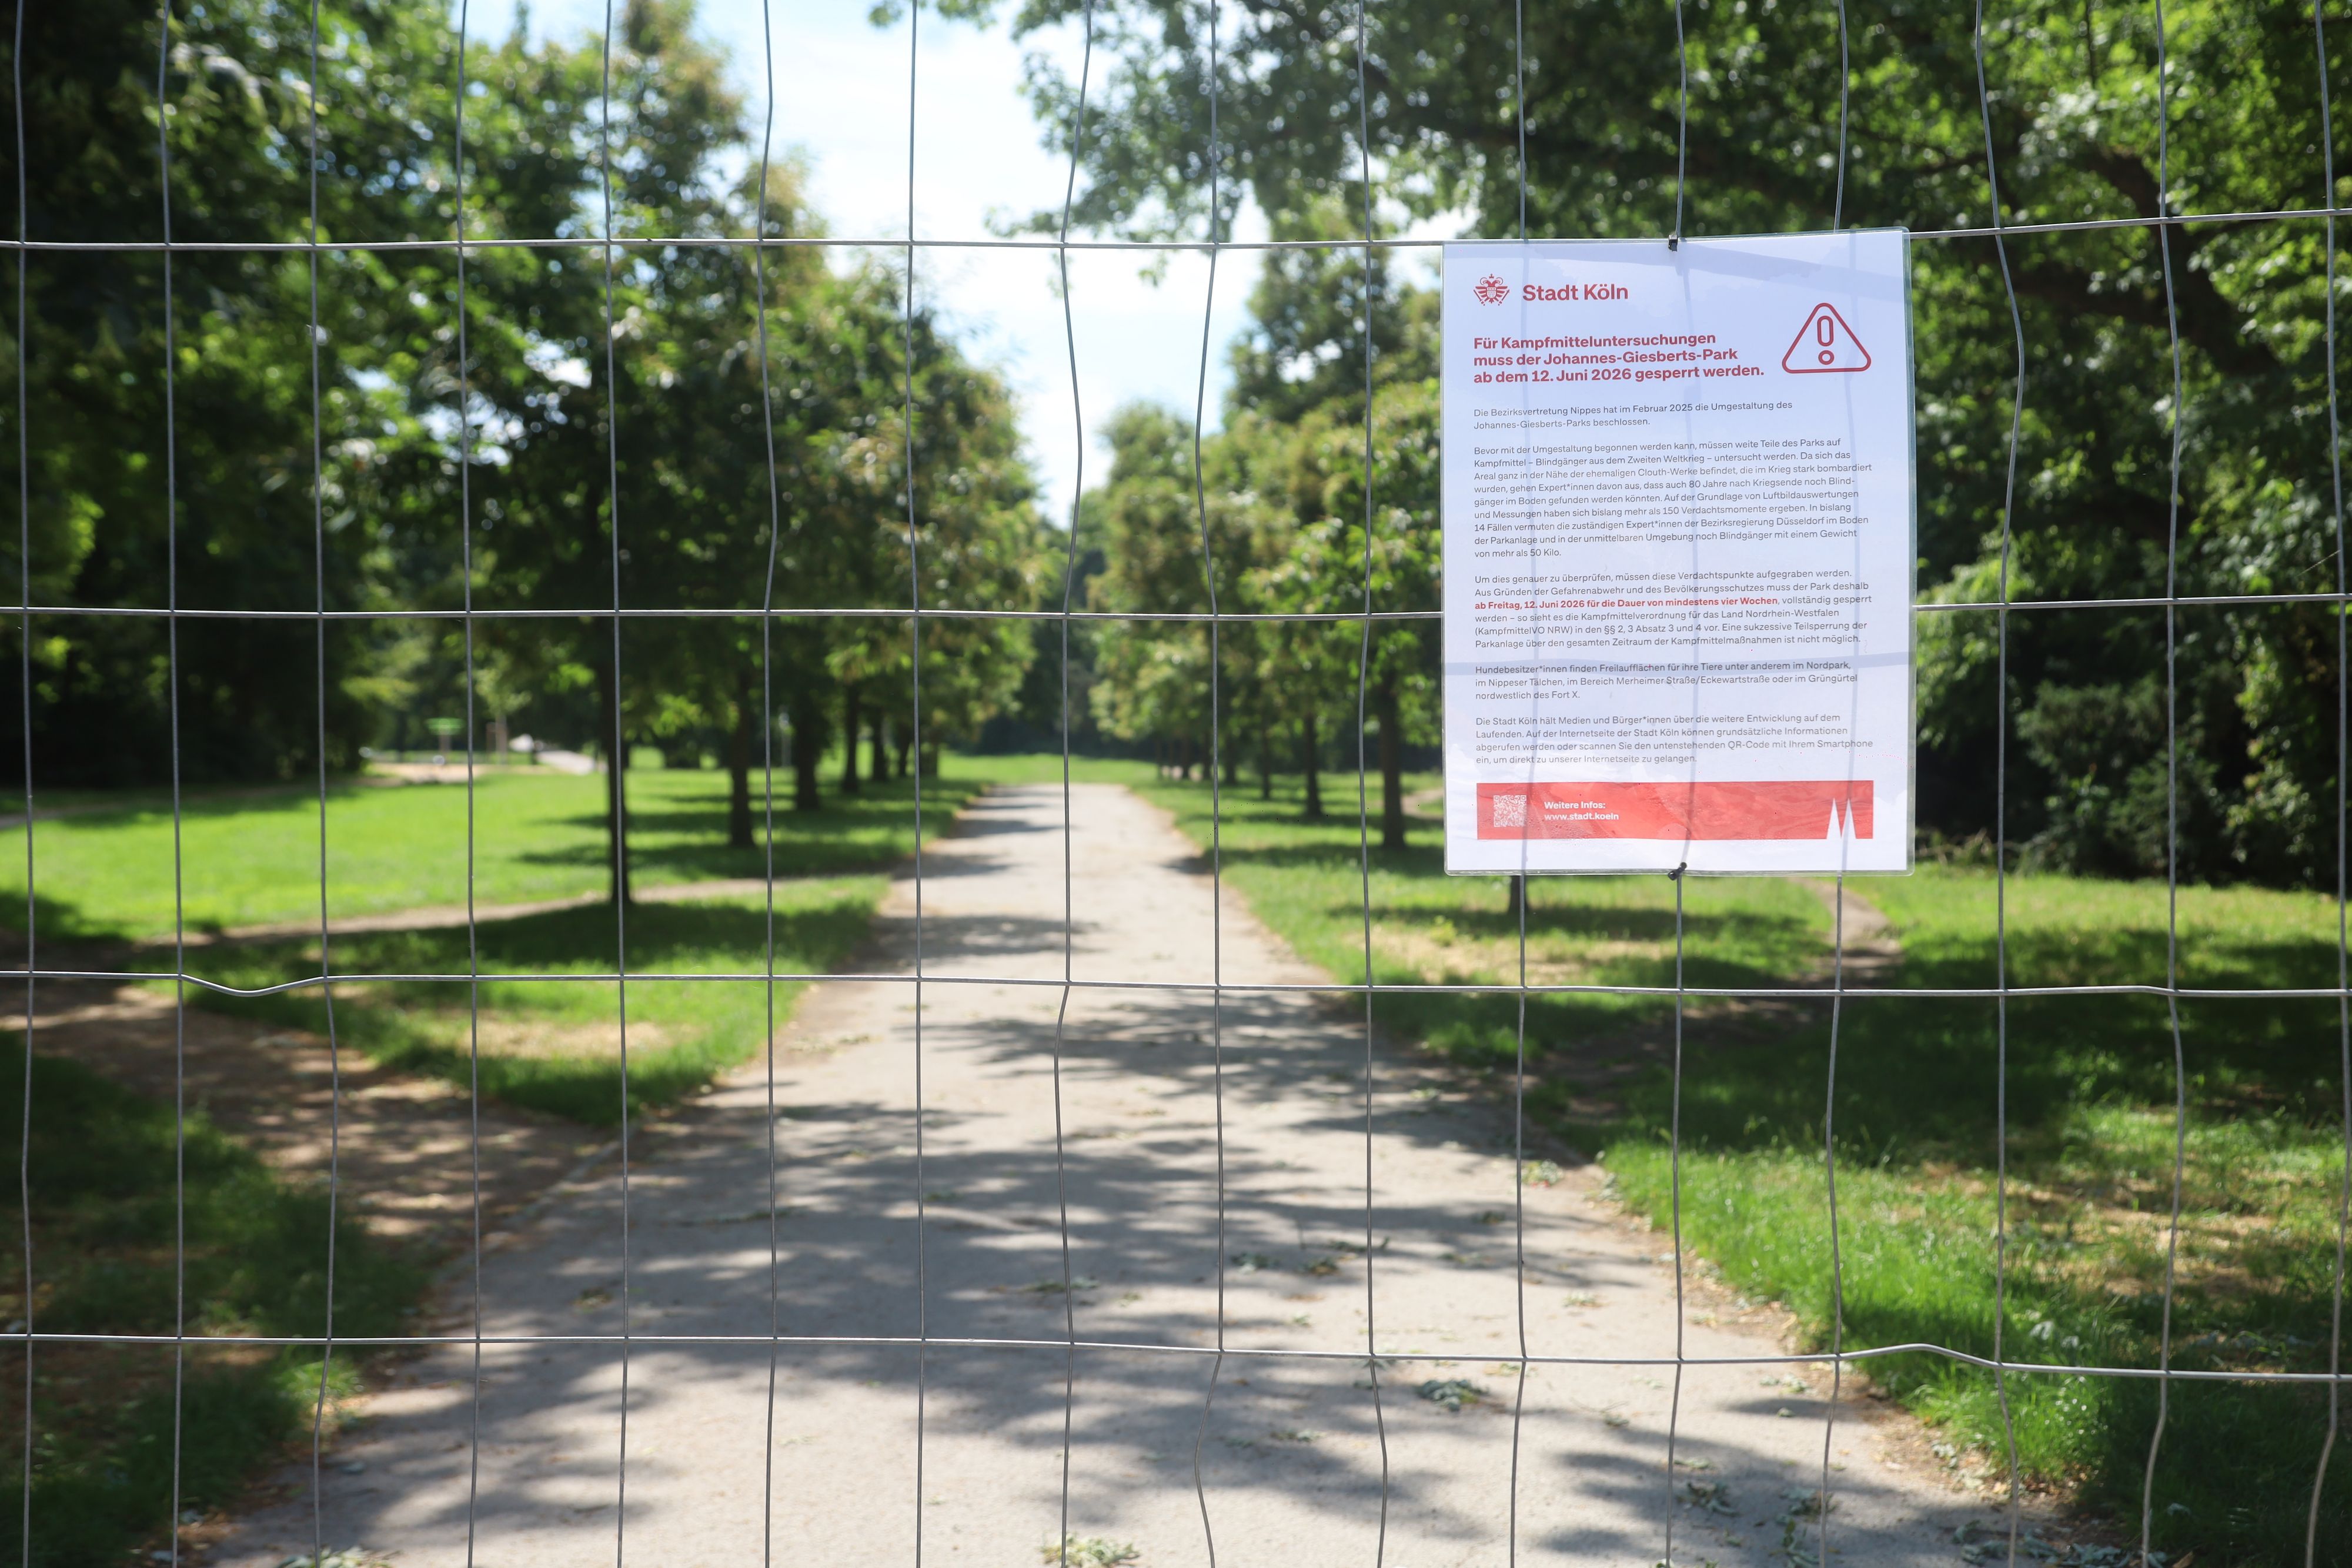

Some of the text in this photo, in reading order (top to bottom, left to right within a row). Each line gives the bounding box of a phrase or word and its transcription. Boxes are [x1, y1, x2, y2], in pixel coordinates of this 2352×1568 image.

[1522, 283, 1628, 302] Stadt Köln
[1474, 333, 1716, 351] Für Kampfmitteluntersuchungen
[1474, 347, 1738, 366] muss der Johannes-Giesberts-Park
[1474, 364, 1765, 383] ab dem 12. Juni 2026 gesperrt werden.
[1474, 409, 1489, 417] Die
[1491, 407, 1568, 417] Bezirksvertretung
[1571, 406, 1601, 416] Nippes
[1619, 405, 1631, 413] im
[1633, 404, 1668, 413] Februar
[1669, 403, 1693, 412] 2025
[1695, 403, 1709, 411] die
[1711, 402, 1774, 412] Umgestaltung
[1474, 418, 1651, 430] Johannes-Giesberts-Parks beschlossen.
[1474, 498, 1504, 508] gänger
[1505, 497, 1516, 505] im
[1518, 497, 1546, 505] Boden
[1548, 496, 1589, 506] gefunden
[1591, 495, 1623, 503] werden
[1625, 494, 1663, 503] könnten.
[1663, 493, 1680, 502] Auf
[1681, 493, 1696, 502] der
[1696, 492, 1743, 502] Grundlage
[1763, 491, 1859, 500] Luftbildauswertungen
[1474, 511, 1491, 519] und
[1492, 510, 1542, 520] Messungen
[1544, 509, 1571, 517] haben
[1572, 509, 1590, 517] sich
[1592, 508, 1622, 518] bislang
[1624, 507, 1647, 516] mehr
[1662, 506, 1679, 515] 150
[1681, 505, 1767, 514] Verdachtsmomente
[1769, 504, 1808, 514] ergeben.
[1819, 503, 1852, 513] bislang
[1474, 524, 1485, 532] 14
[1487, 523, 1512, 531] Fällen
[1514, 523, 1555, 531] vermuten
[1556, 521, 1570, 530] die
[1572, 521, 1624, 531] zuständigen
[1684, 519, 1699, 527] der
[1700, 518, 1774, 528] Bezirksregierung
[1776, 516, 1825, 526] Düsseldorf
[1839, 516, 1869, 524] Boden
[1492, 549, 1515, 557] mehr
[1516, 549, 1528, 557] als
[1529, 549, 1542, 557] 50
[1544, 548, 1562, 556] Kilo.
[1475, 576, 1490, 584] Um
[1492, 575, 1511, 583] dies
[1512, 576, 1548, 585] genauer
[1562, 573, 1613, 583] überprüfen,
[1615, 573, 1650, 581] müssen
[1652, 572, 1676, 580] diese
[1678, 571, 1754, 580] Verdachtspunkte
[1756, 570, 1813, 580] aufgegraben
[1815, 569, 1852, 577] werden.
[1474, 589, 1492, 597] Aus
[1493, 588, 1532, 596] Gründen
[1534, 587, 1549, 596] der
[1551, 586, 1625, 596] Gefahrenabwehr
[1626, 586, 1643, 594] und
[1663, 584, 1765, 594] Bevölkerungsschutzes
[1793, 583, 1808, 591] der
[1810, 583, 1831, 591] Park
[1833, 581, 1869, 590] deshalb
[1475, 601, 1486, 610] ab
[1488, 601, 1522, 611] Freitag,
[1524, 600, 1538, 609] 12.
[1539, 600, 1559, 609] Juni
[1560, 600, 1585, 608] 2026
[1601, 599, 1616, 607] die
[1618, 599, 1646, 607] Dauer
[1665, 598, 1719, 606] mindestens
[1720, 597, 1739, 605] vier
[1739, 597, 1780, 605] Wochen,
[1782, 596, 1831, 606] vollständig
[1833, 596, 1872, 605] gesperrt
[1475, 634, 1861, 650] Parkanlage über den gesamten Zeitraum der Kampfmittelmaßnahmen ist nicht möglich.
[1569, 664, 1598, 673] finden
[1599, 663, 1665, 672] Freilaufflächen
[1667, 663, 1681, 671] für
[1682, 663, 1699, 671] ihre
[1700, 663, 1723, 671] Tiere
[1725, 663, 1749, 671] unter
[1750, 662, 1790, 670] anderem
[1793, 661, 1804, 670] im
[1806, 661, 1851, 671] Nordpark,
[1475, 678, 1486, 687] im
[1488, 678, 1528, 688] Nippeser
[1567, 677, 1578, 686] im
[1580, 677, 1614, 686] Bereich
[1616, 677, 1665, 685] Merheimer
[1666, 675, 1770, 685] Straße/Eckewartstraße
[1772, 675, 1793, 683] oder
[1795, 674, 1806, 683] im
[1808, 674, 1857, 684] Grüngürtel
[1475, 691, 1532, 700] nordwestlich
[1533, 691, 1549, 699] des
[1552, 691, 1570, 699] Fort
[1476, 727, 1848, 738] Laufenden. Auf der Internetseite der Stadt Köln können grundsätzliche Informationen
[1544, 801, 1606, 810] Weitere Infos:
[1544, 812, 1619, 821] www.stadt.koeln
